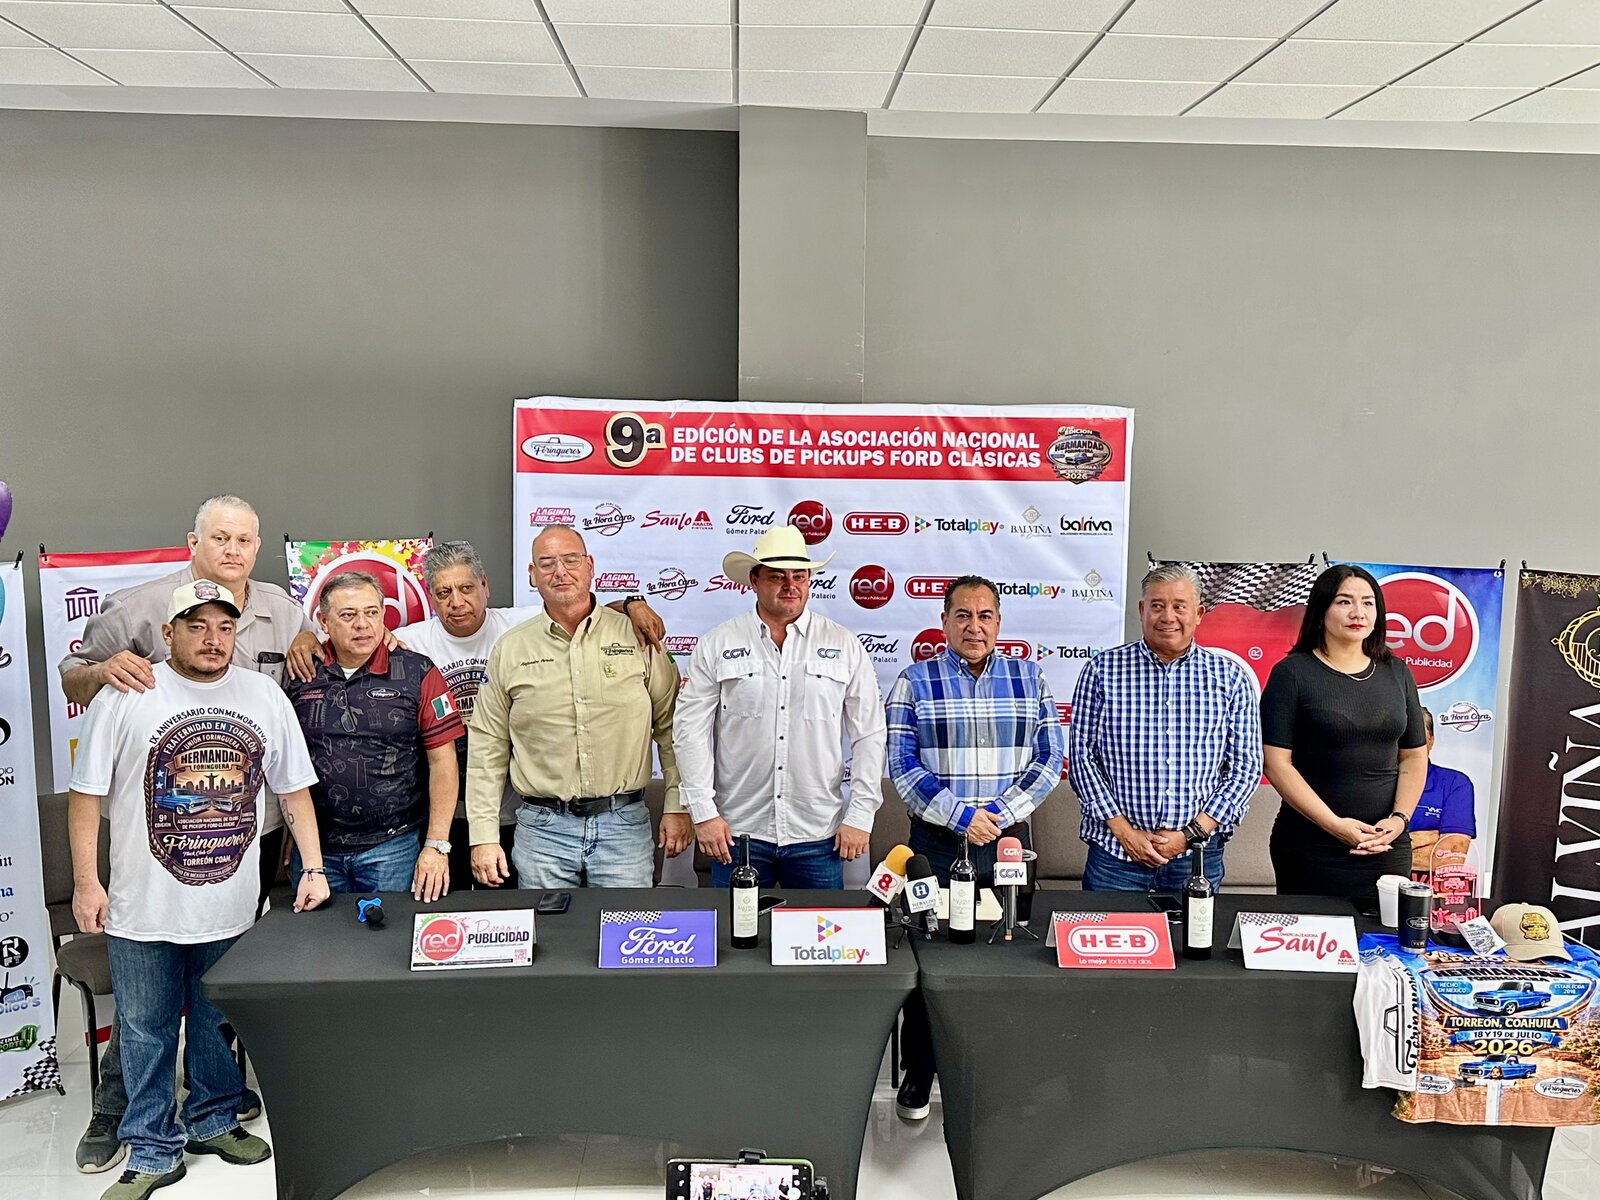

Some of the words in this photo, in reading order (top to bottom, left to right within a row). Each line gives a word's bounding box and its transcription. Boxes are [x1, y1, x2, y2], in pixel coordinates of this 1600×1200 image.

[673, 424, 753, 445] EDICIÓN
[758, 430, 785, 446] DE
[789, 431, 814, 446] LA
[817, 427, 937, 448] ASOCIACIÓN
[942, 431, 1040, 449] NACIONAL
[1055, 440, 1104, 452] HERMANDAD
[671, 447, 697, 463] DE
[701, 447, 764, 464] CLUBS
[770, 448, 795, 465] DE
[800, 449, 885, 466] PICKUPS
[890, 451, 943, 468] FORD
[948, 448, 1042, 469] CLÁSICAS
[536, 508, 570, 516] LAGUNA
[640, 510, 692, 530] Saulo
[726, 504, 775, 525] Ford
[788, 503, 827, 529] red
[582, 518, 592, 527] La
[593, 515, 613, 524] Hora
[934, 517, 1000, 536] Totalplay
[1011, 523, 1052, 534] BALVIÑA
[601, 573, 635, 581] LAGUNA
[851, 569, 888, 595] red
[646, 582, 656, 592] La
[658, 579, 677, 588] Hora
[996, 583, 1060, 599] Totalplay
[1072, 588, 1114, 598] BALVIÑA
[811, 592, 836, 600] Palacio
[1385, 590, 1457, 652] ed
[1406, 656, 1453, 669] Publicidad
[156, 707, 205, 737] ANIVERSARIO
[207, 707, 268, 743] CONMEMORATIVO
[1440, 714, 1449, 722] La
[1451, 713, 1470, 721] Hora
[163, 722, 212, 755] FRATERNIDAD
[215, 721, 226, 731] EN
[202, 733, 240, 749] FORINGUERA
[180, 749, 241, 764] HERMANDAD
[1549, 703, 1600, 956] ALVIÑA
[163, 833, 245, 854] Foringueros
[183, 856, 213, 866] TORREÓN
[914, 884, 928, 897] H
[421, 921, 461, 949] red
[468, 931, 530, 944] PUBLICIDAD
[620, 927, 697, 955] Ford
[1253, 926, 1338, 960] Saulo
[621, 956, 655, 964] Gómez
[657, 956, 695, 964] Palacio
[790, 945, 866, 963] Totalplay
[1433, 966, 1572, 979] HERMANDAD
[1450, 1015, 1503, 1029] TORREÓN,
[1505, 1018, 1560, 1029] COAHUILA
[1473, 1031, 1483, 1039] 18
[1485, 1031, 1491, 1039] Y
[1492, 1030, 1502, 1038] 19
[1517, 1031, 1542, 1039] JULIO
[1473, 1039, 1534, 1056] 2026
